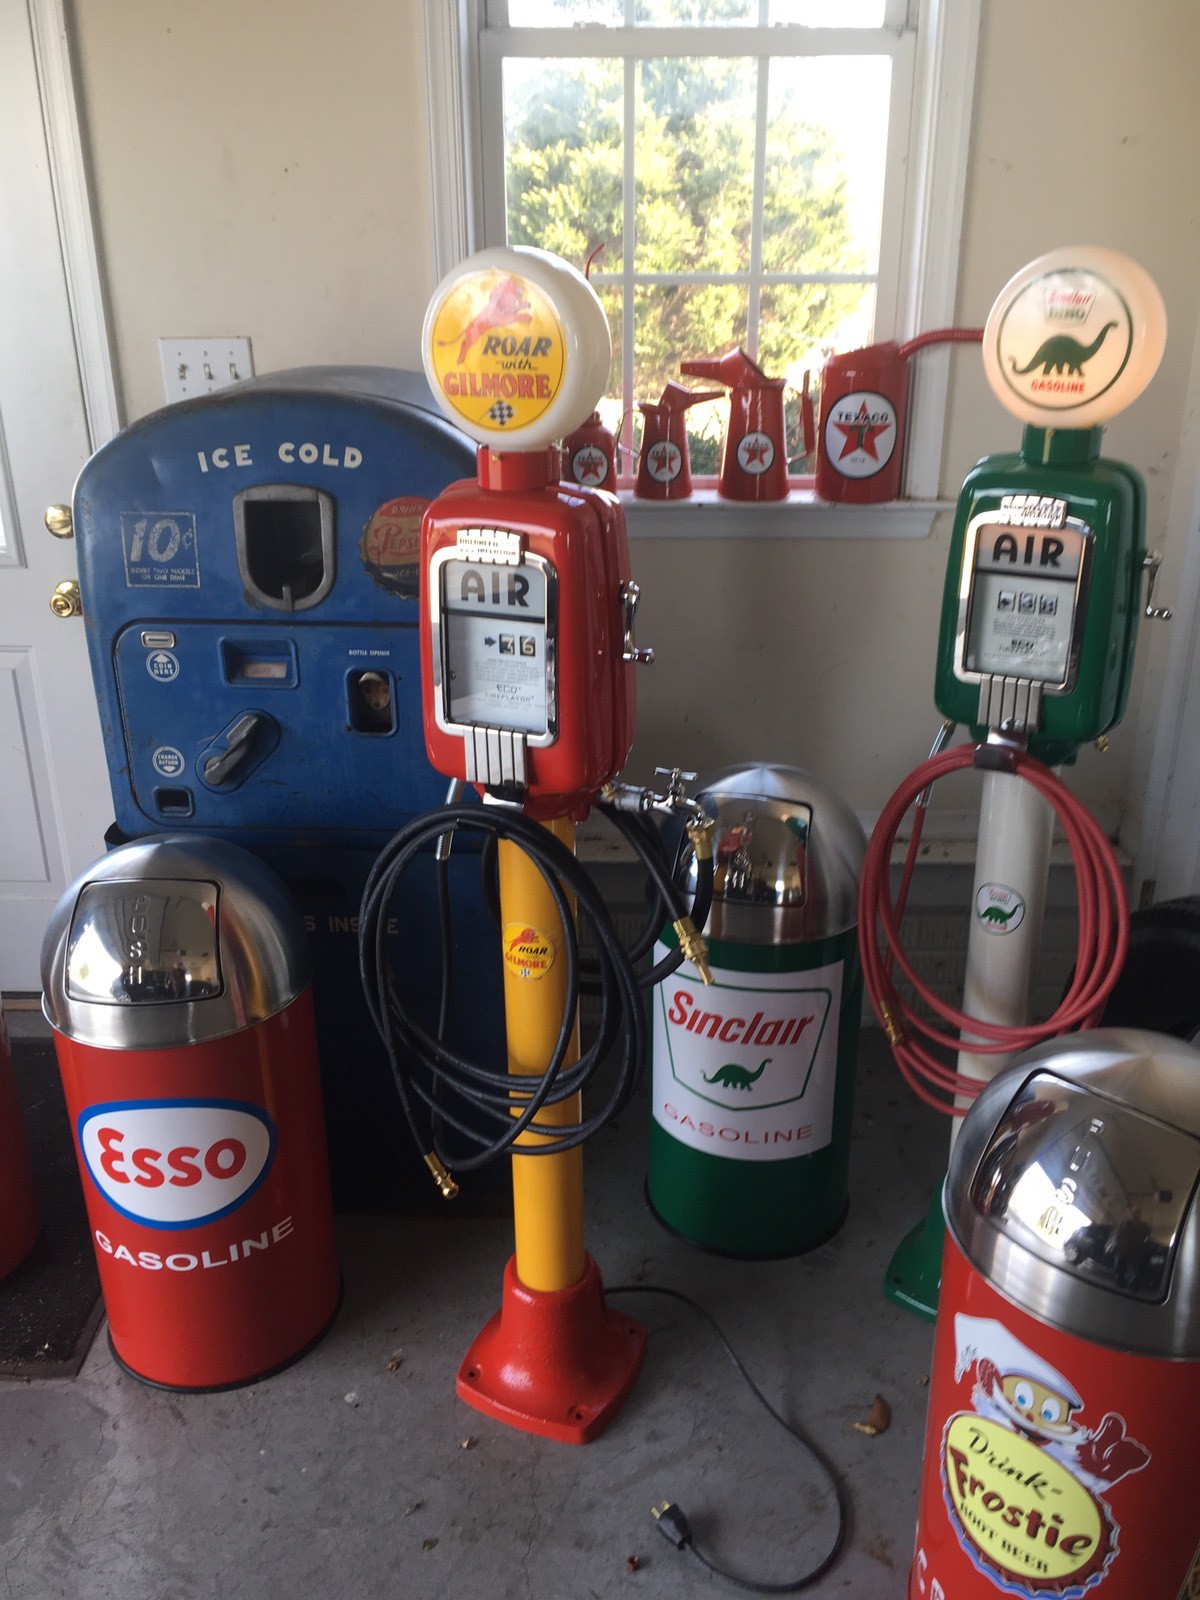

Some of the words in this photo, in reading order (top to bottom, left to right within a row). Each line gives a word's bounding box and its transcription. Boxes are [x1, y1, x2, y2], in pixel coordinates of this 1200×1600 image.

[481, 336, 553, 358] ROAR
[443, 372, 552, 399] GILMORE
[1030, 379, 1086, 395] GASOLINE
[837, 410, 889, 424] TEXACO
[197, 444, 253, 473] ICE
[277, 442, 363, 469] COLD
[992, 532, 1065, 570] AIR
[460, 567, 531, 609] AIR
[348, 649, 367, 657] BOTTLE
[369, 649, 390, 658] OPENER
[153, 662, 173, 670] COIN
[153, 668, 174, 676] HERE
[158, 759, 179, 767] RETURN
[328, 916, 399, 934] INSE
[505, 951, 547, 970] GILMORE
[518, 945, 549, 956] ROAR
[668, 990, 816, 1047] Sinclair
[664, 1102, 813, 1145] GASOLINE
[95, 1215, 295, 1273] GASOLINE
[949, 1445, 1093, 1558] Frostie
[1001, 1538, 1050, 1576] BEER
